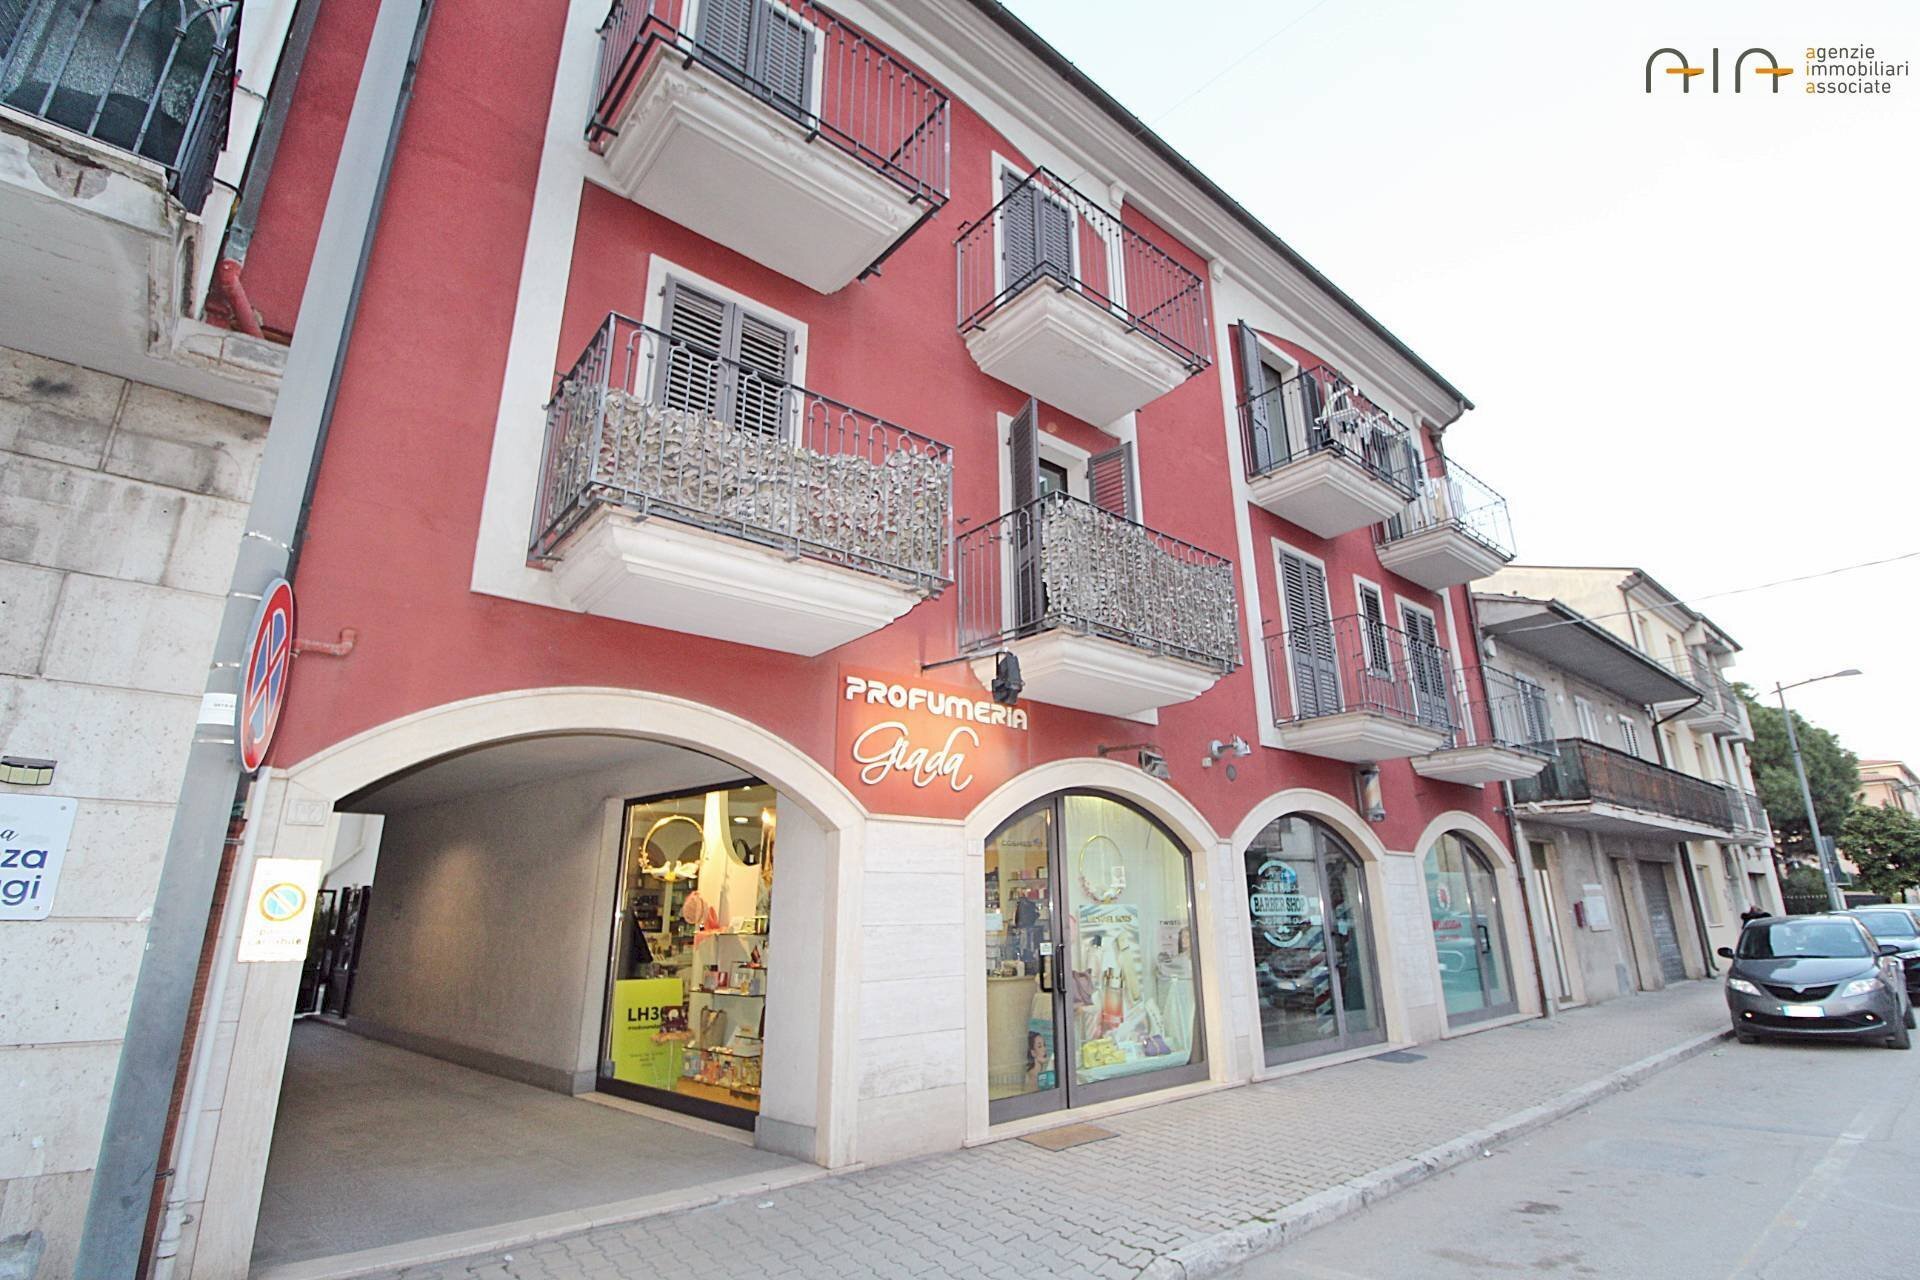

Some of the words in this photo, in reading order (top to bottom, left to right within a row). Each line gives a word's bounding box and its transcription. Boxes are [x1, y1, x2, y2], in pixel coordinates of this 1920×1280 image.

[846, 676, 1028, 730] PROFUMERIA
[853, 721, 979, 791] Giada
[0, 875, 42, 906] gi
[628, 1006, 664, 1021] LH3
